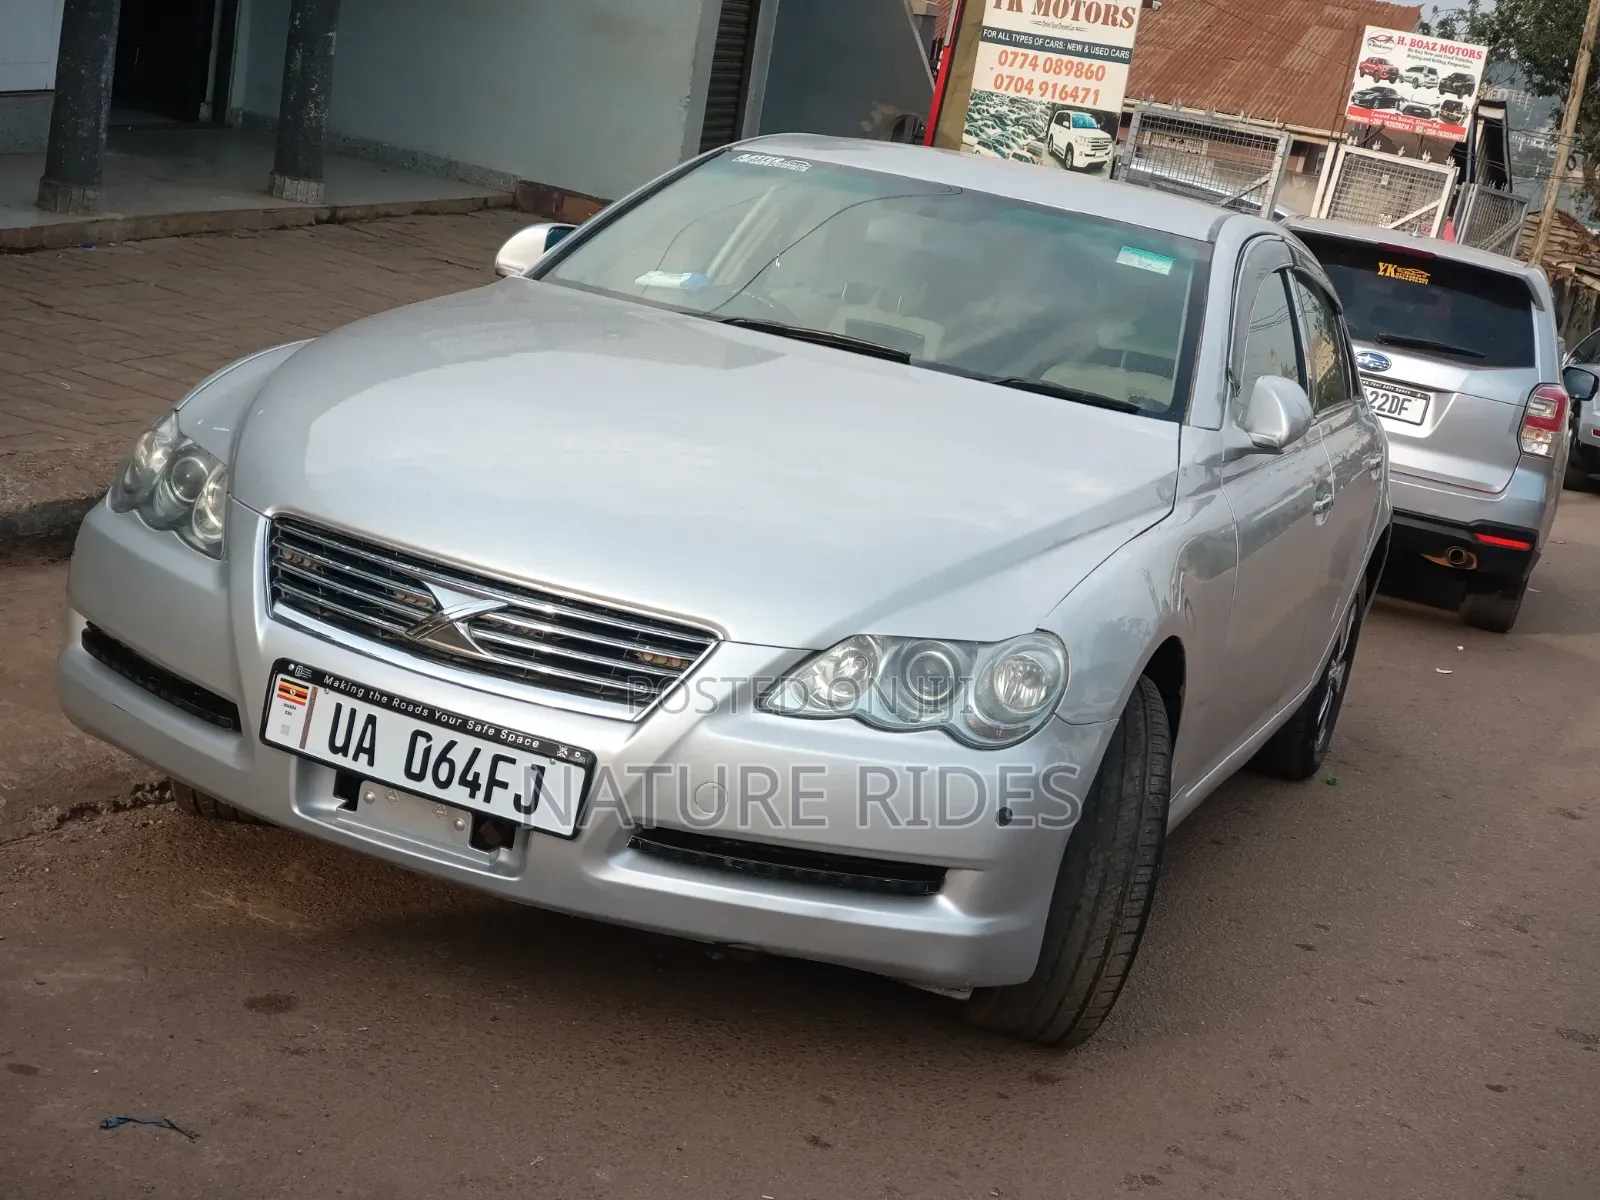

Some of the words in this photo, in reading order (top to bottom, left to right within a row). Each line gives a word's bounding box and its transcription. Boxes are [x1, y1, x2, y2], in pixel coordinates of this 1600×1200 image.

[1031, 0, 1136, 29] MOTORS
[983, 29, 997, 38] FOR
[998, 32, 1010, 40] ALL
[1012, 34, 1033, 44] TYPES
[1034, 37, 1044, 45] OF
[1045, 39, 1066, 49] CARS:
[1067, 43, 1083, 51] NEW
[1084, 45, 1089, 53] &
[1091, 46, 1109, 55] USED
[1111, 49, 1130, 59] CARS
[1397, 36, 1407, 46] H.
[1409, 38, 1438, 52] BOAZ
[1439, 43, 1483, 60] MOTORS
[998, 49, 1039, 72] 0774
[1042, 59, 1106, 82] 089860
[993, 73, 1034, 96] 0704
[1038, 80, 1101, 106] 916471
[1377, 262, 1397, 277] YK
[1365, 389, 1412, 416] 22DF
[323, 674, 365, 698] Making
[368, 690, 388, 703] the
[392, 697, 429, 717] Roads
[433, 709, 463, 726] Your
[466, 720, 495, 736] Safe
[499, 729, 540, 748] Space
[328, 702, 378, 768] UA
[403, 728, 547, 817] 064FJ
